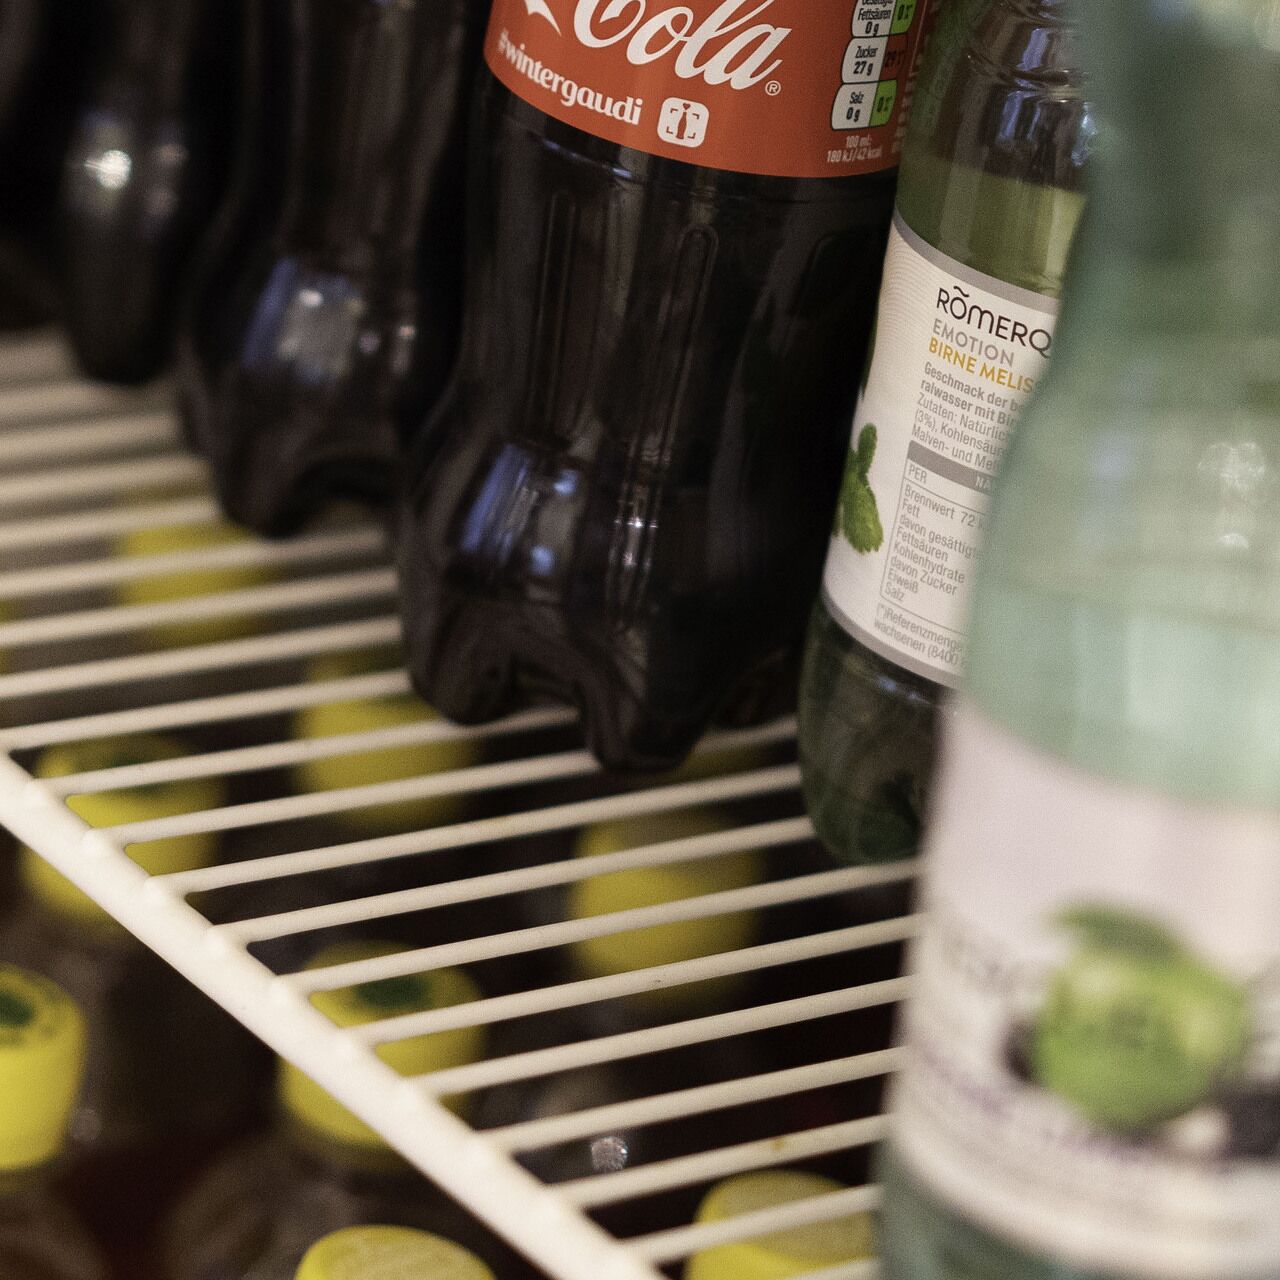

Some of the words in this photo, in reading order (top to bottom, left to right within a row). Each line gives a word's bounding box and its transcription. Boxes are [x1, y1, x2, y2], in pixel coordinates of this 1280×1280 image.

[853, 61, 867, 74] 27
[855, 46, 878, 59] Zucker
[497, 28, 643, 125] #wintergaudi
[849, 91, 864, 104] Salz
[932, 318, 1014, 367] EMOTION
[928, 336, 977, 374] BIRNE
[979, 362, 1034, 394] MELIS
[920, 380, 973, 412] ralwasser
[974, 405, 995, 422] mit
[924, 361, 985, 401] Geschmack
[987, 392, 1008, 408] der
[917, 392, 957, 423] Zutaten:
[912, 424, 949, 451] Malven-
[951, 447, 973, 463] und
[908, 463, 927, 484] PER
[902, 498, 920, 518] Fett
[904, 484, 956, 520] Brennwert
[960, 511, 976, 528] 72
[896, 525, 948, 562] Fettsäuren
[900, 514, 926, 537] davon
[890, 556, 918, 579] davon
[920, 569, 958, 596] Zucker
[893, 541, 965, 583] Kohlenhydrate
[884, 581, 905, 602] Salz
[887, 568, 918, 594] Eiweiß
